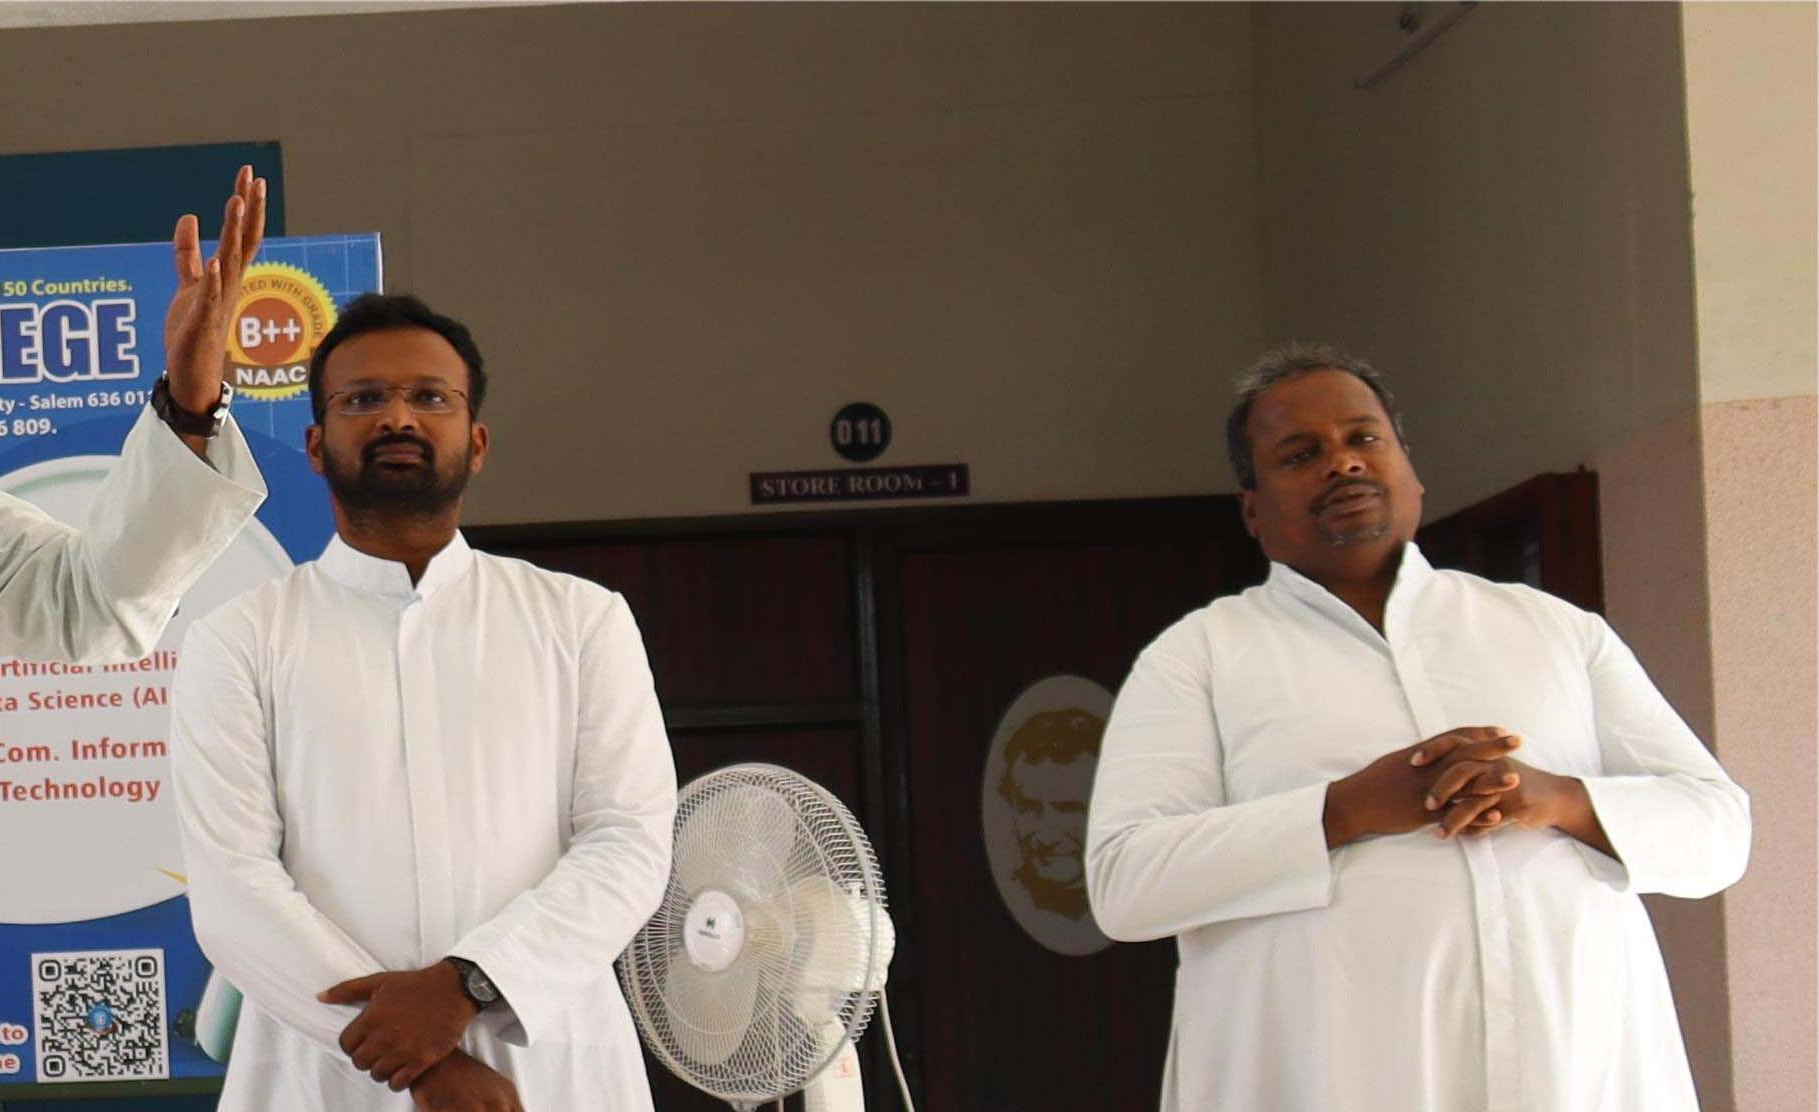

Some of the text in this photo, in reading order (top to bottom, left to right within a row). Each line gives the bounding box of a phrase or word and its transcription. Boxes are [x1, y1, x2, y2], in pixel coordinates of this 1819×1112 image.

[31, 276, 133, 296] Countries.
[271, 279, 303, 297] WITH
[239, 316, 302, 349] B++
[235, 365, 307, 386] NAAC
[30, 394, 83, 410] Salem
[88, 392, 121, 408] 636
[13, 418, 57, 436] 809.
[837, 418, 882, 446] 011
[762, 475, 842, 497] STORE
[849, 474, 923, 493] ROOM
[949, 471, 958, 489] 1
[28, 690, 123, 711] Science
[72, 737, 167, 760] Inform
[2, 1027, 24, 1042] to
